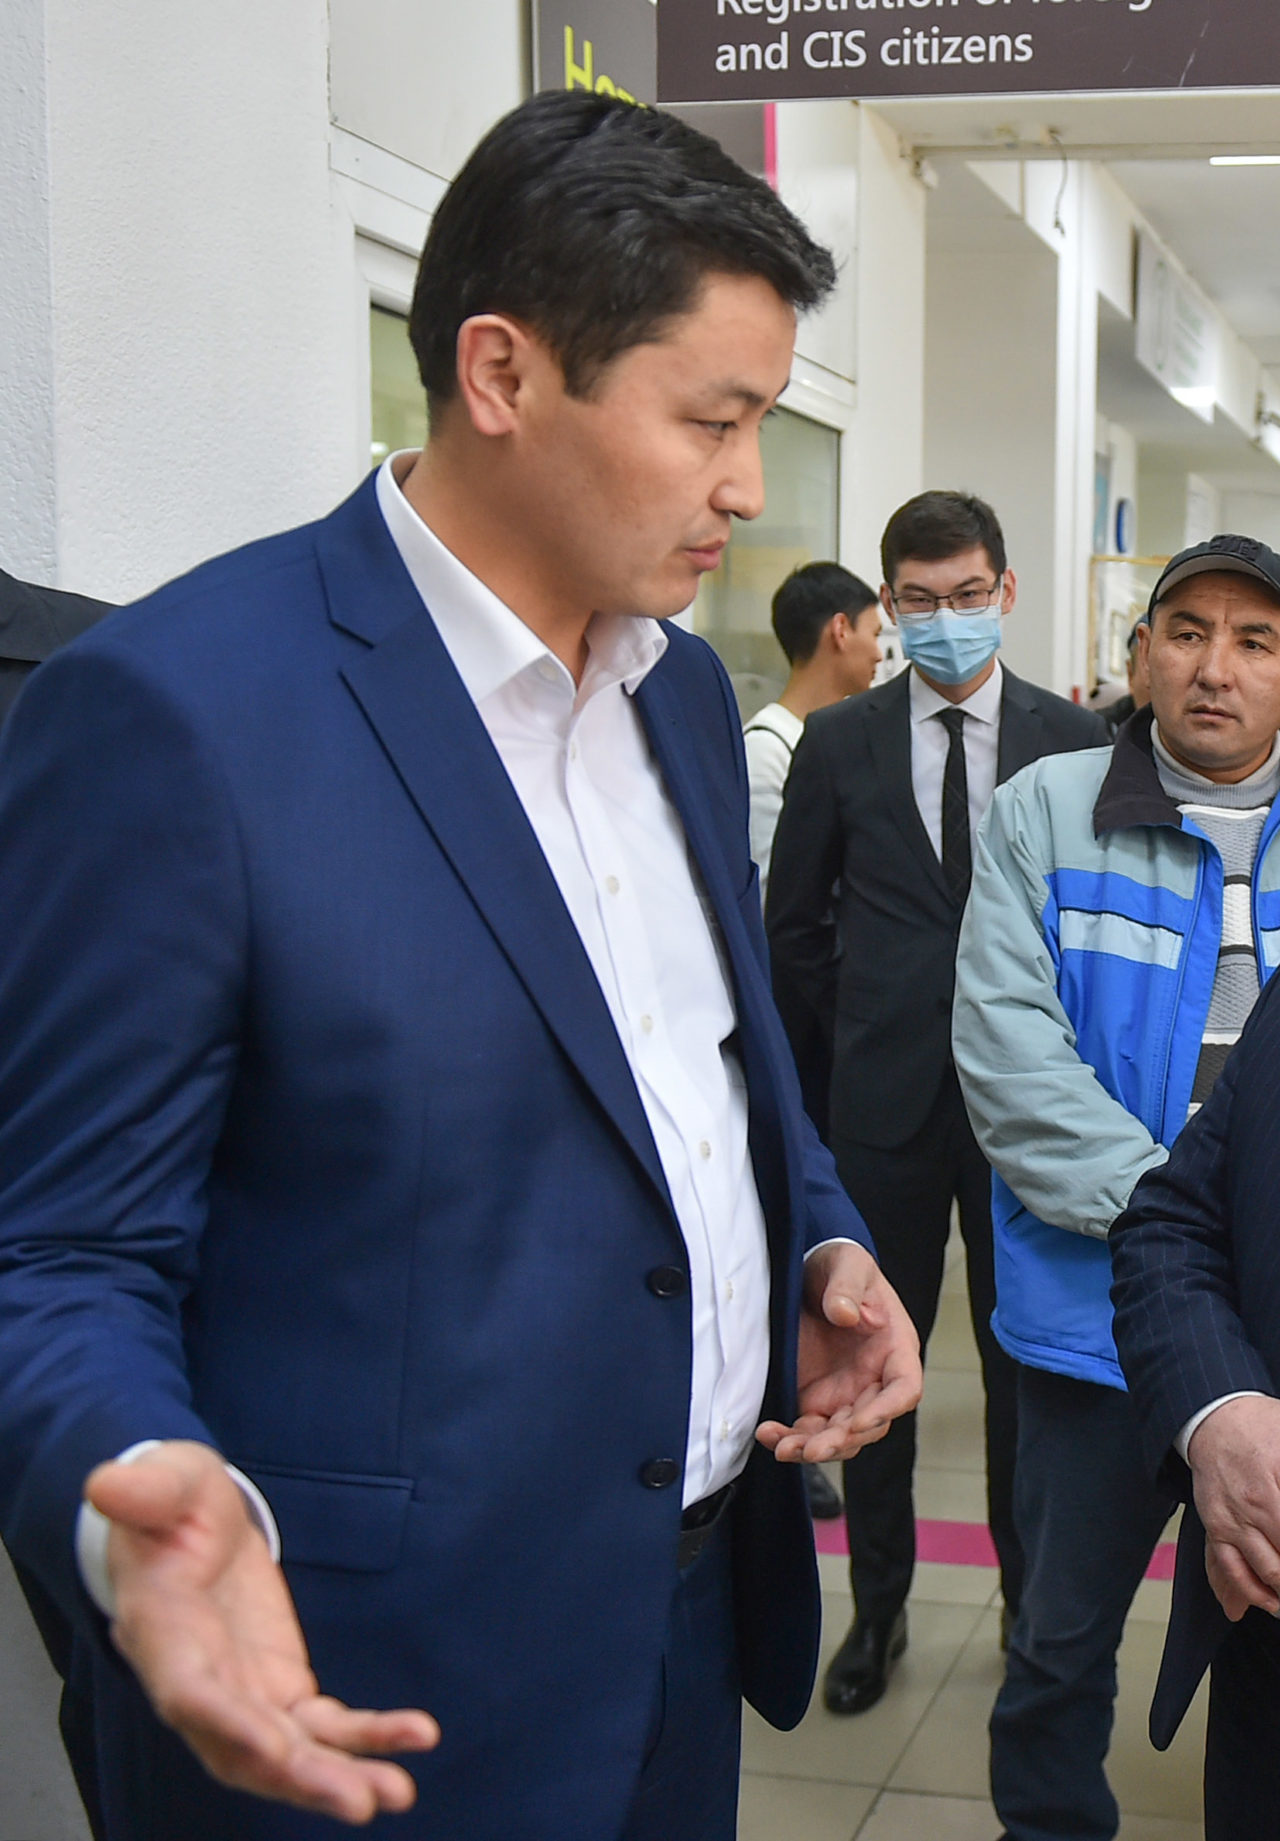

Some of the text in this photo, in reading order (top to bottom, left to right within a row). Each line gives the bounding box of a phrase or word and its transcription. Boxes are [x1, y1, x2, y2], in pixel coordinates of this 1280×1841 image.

[715, 26, 1033, 72] and CIS citizens
